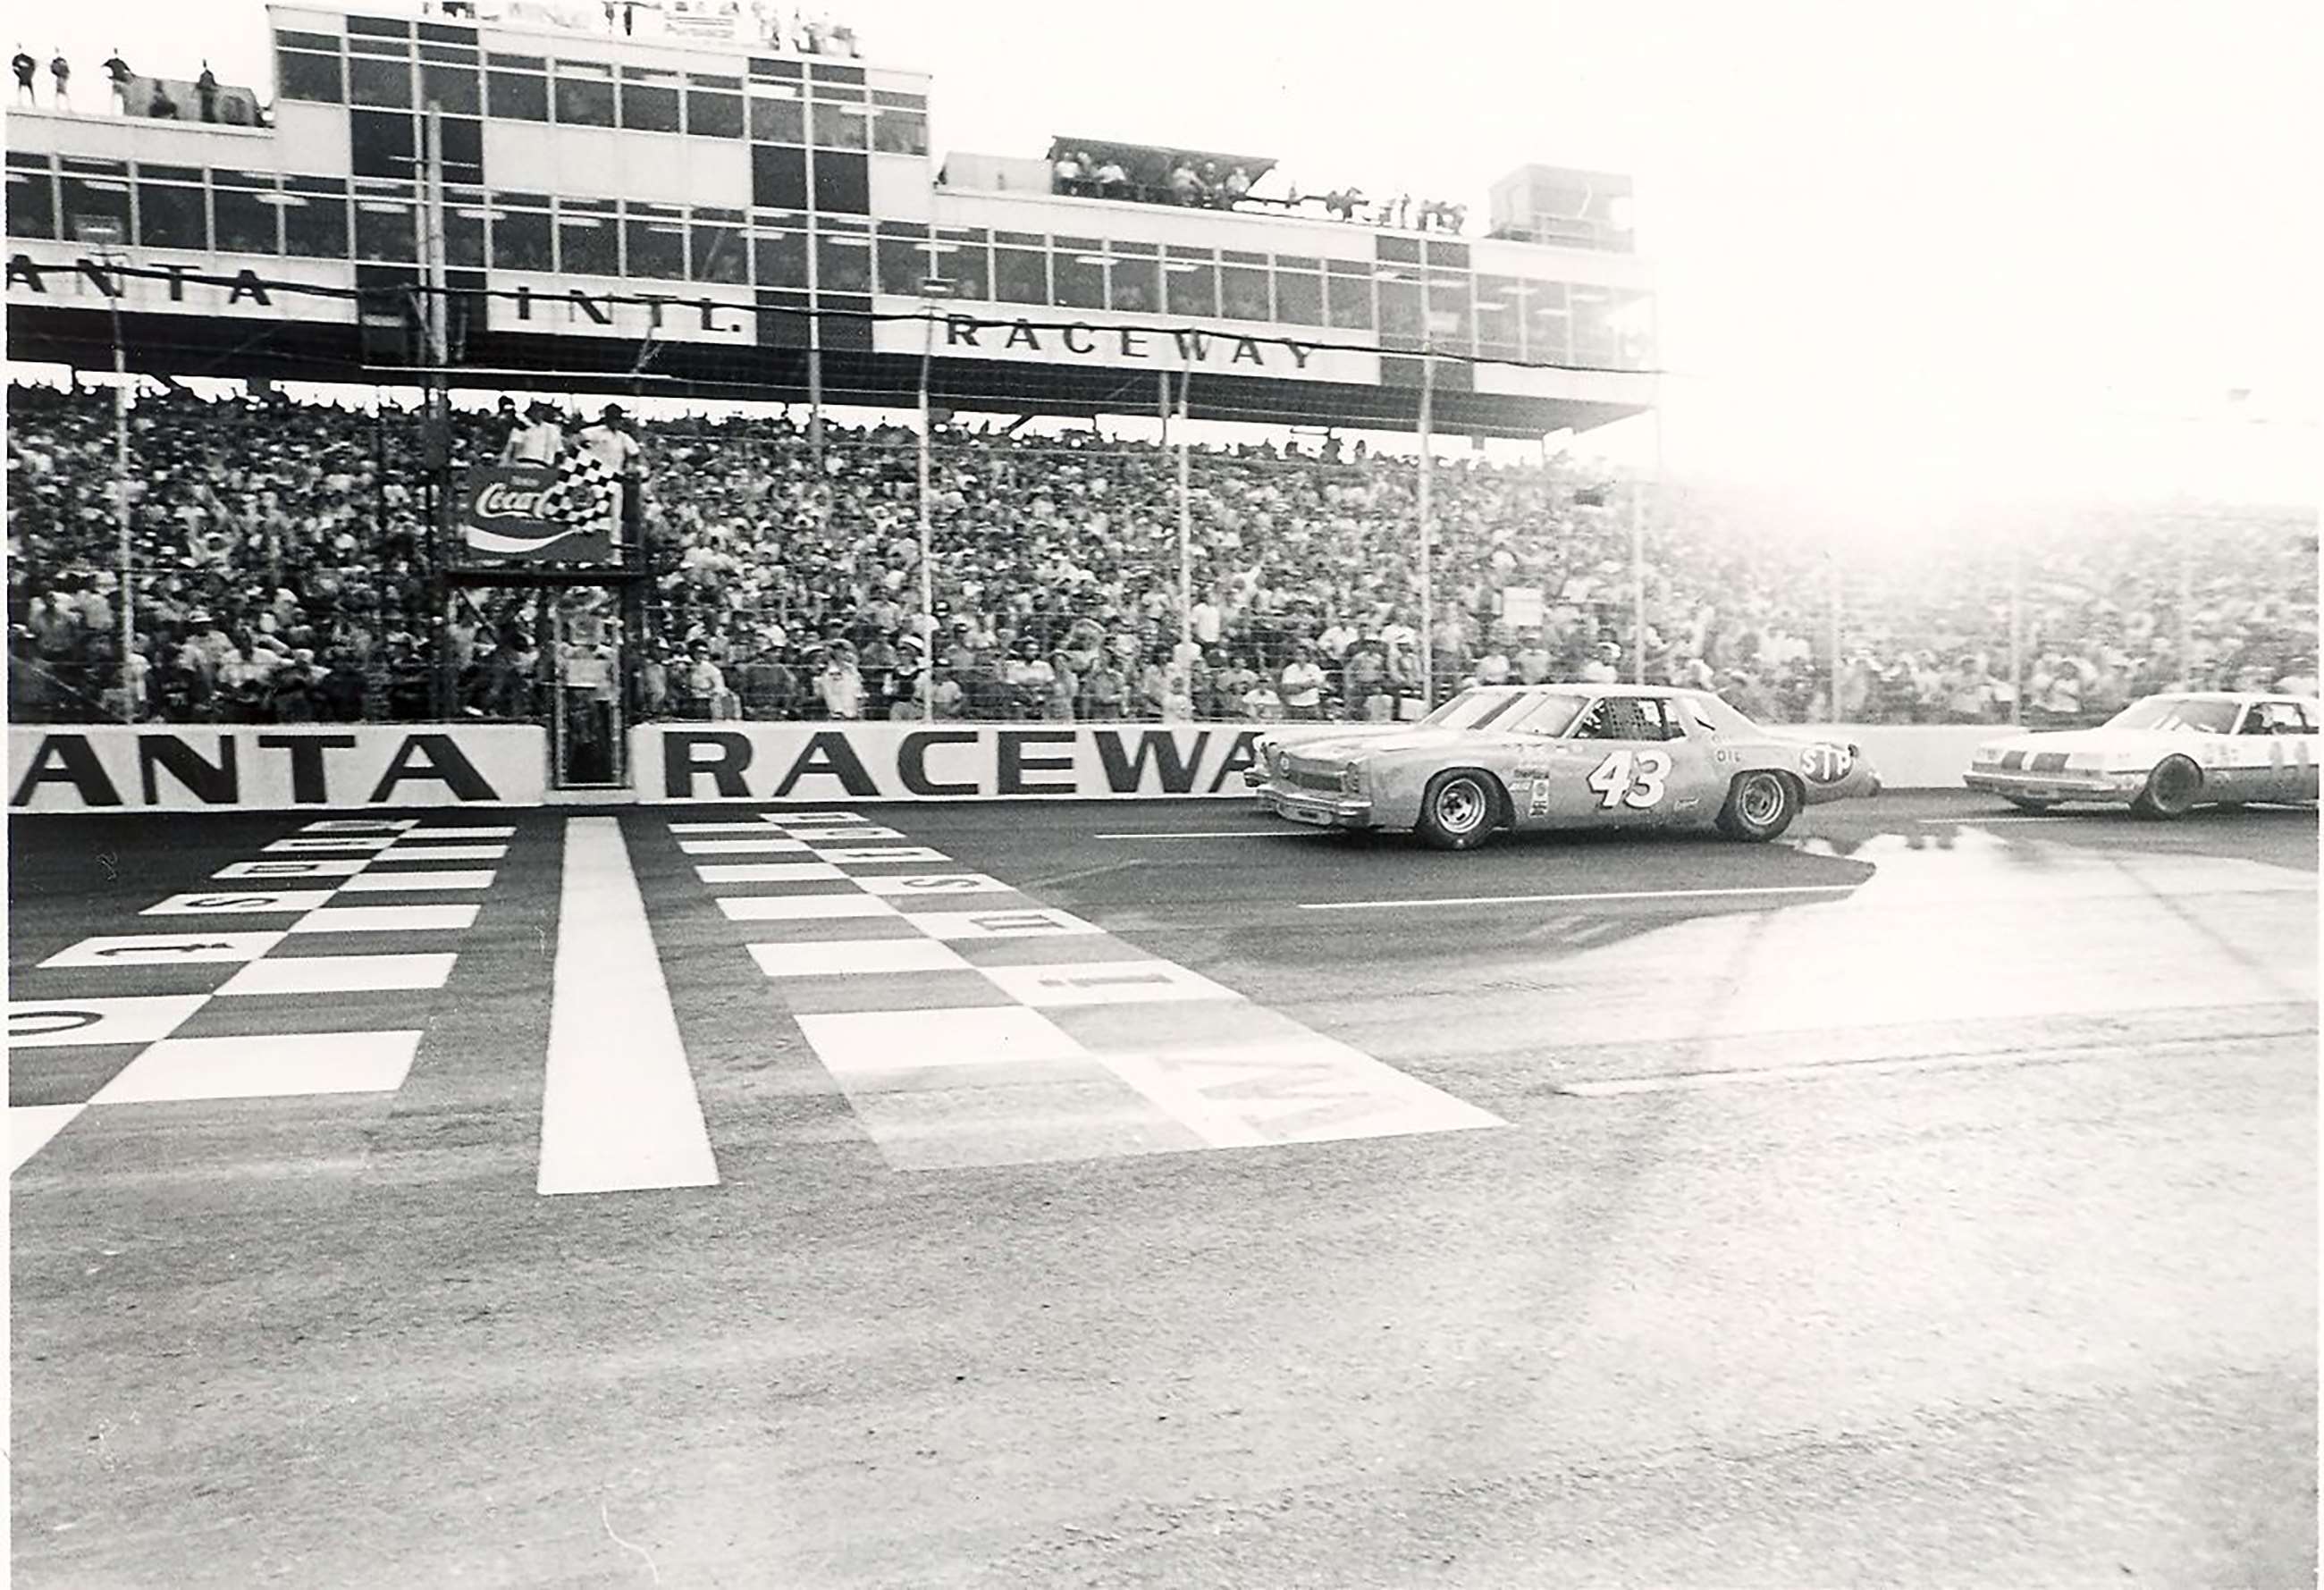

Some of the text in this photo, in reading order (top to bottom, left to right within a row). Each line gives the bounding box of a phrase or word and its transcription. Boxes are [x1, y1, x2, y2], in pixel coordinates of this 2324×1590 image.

[6, 254, 1321, 368] ANTA INTL. RACEWAY
[11, 734, 501, 806] ANTA
[1586, 751, 1671, 809] 43
[1801, 745, 1852, 780] STP
